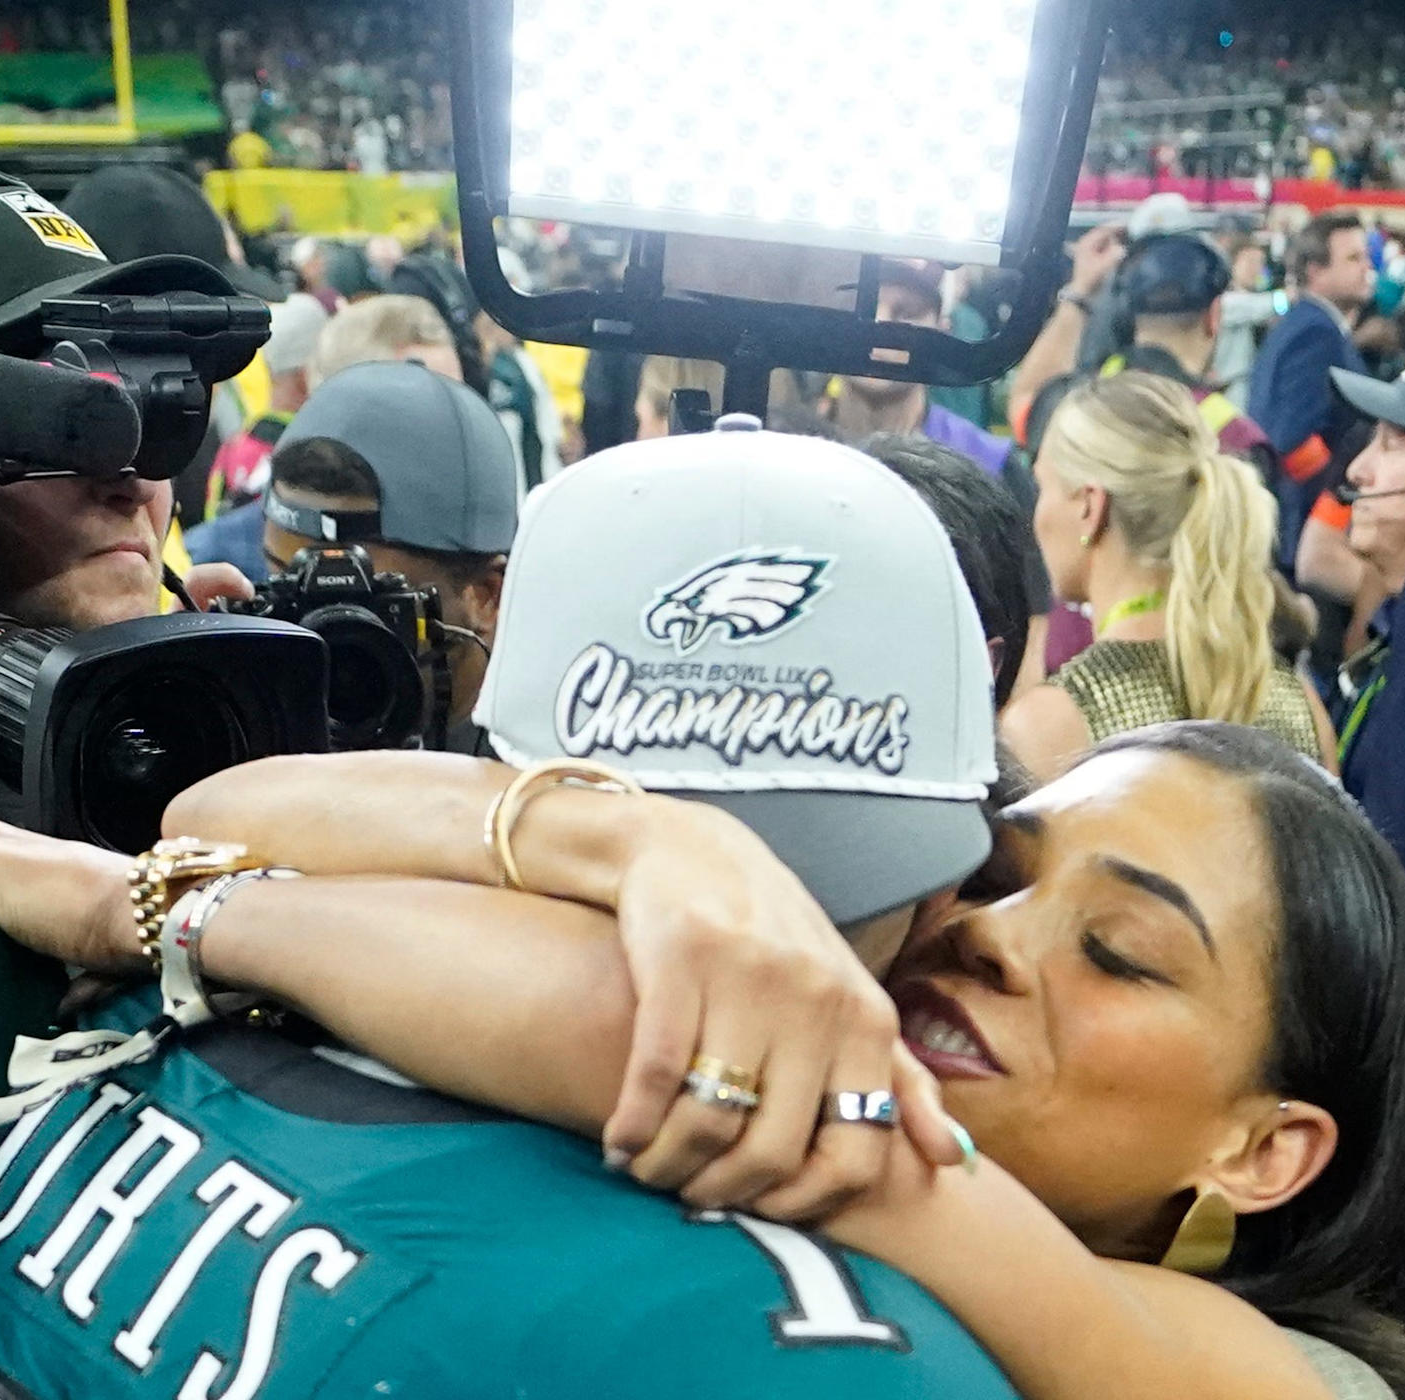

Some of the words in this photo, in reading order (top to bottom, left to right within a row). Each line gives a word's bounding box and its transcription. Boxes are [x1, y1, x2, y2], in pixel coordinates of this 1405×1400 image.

[316, 575, 356, 586] SONY
[633, 661, 705, 681] SUPER
[706, 663, 767, 682] BOWL
[774, 664, 807, 684] LIX
[554, 643, 909, 775] Champions
